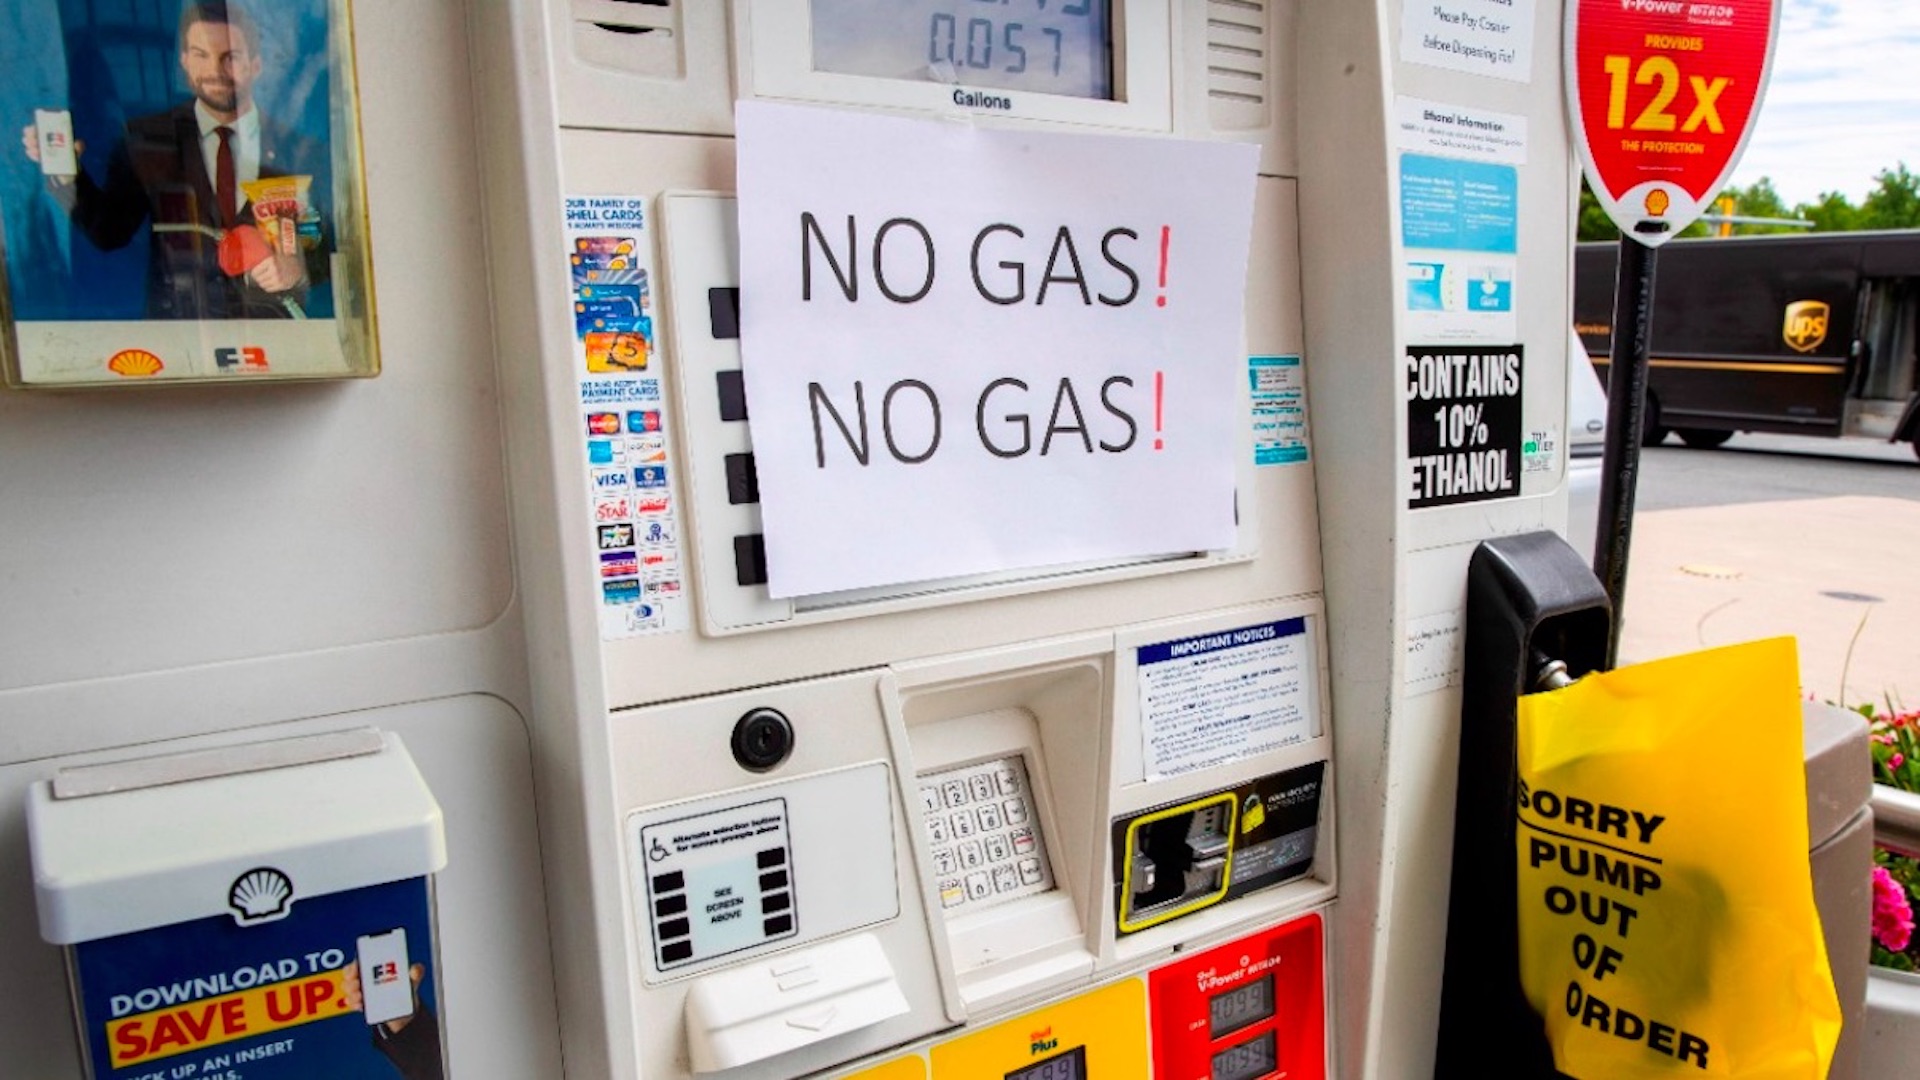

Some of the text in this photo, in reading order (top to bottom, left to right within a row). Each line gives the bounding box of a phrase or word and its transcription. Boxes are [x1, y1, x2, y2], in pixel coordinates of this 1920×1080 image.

[1434, 5, 1460, 23] Please
[1462, 12, 1477, 31] Pay
[929, 13, 1062, 77] 0.057
[1644, 34, 1703, 51] PROVIDES
[953, 89, 1012, 110] Gallons
[1423, 110, 1504, 132] Ethanol Information
[1621, 139, 1705, 154] THE PROTECTION
[566, 209, 643, 220] SHELL CARDS
[590, 200, 624, 208] FAMILY
[627, 200, 641, 208] OF
[800, 211, 1171, 308] NO GAS!
[1406, 354, 1520, 401] CONTAINS
[582, 386, 659, 397] PAYMENT CARDS
[808, 370, 1164, 468] NO GAS!
[1434, 402, 1490, 448] 10%
[596, 474, 627, 486] VISA
[1407, 449, 1513, 500] ETHANOL
[1171, 626, 1276, 656] IMPORTANT NOTICES
[1517, 777, 1665, 844] SORRY
[673, 816, 781, 843] Alternate selection buttons
[691, 839, 719, 849] screen
[756, 825, 779, 835] above
[1530, 836, 1662, 896] PUMP
[706, 897, 744, 914] SCREEN
[714, 886, 732, 898] SEE
[711, 910, 742, 924] ABOVE
[1544, 886, 1638, 938] OUT
[1572, 933, 1624, 981] OF
[110, 948, 345, 1017] DOWNLOAD TO
[1198, 968, 1246, 992] V-Power
[115, 979, 348, 1061] SAVE UP.
[1565, 980, 1711, 1070] ORDER
[171, 1063, 197, 1079] UP
[202, 1054, 230, 1072] AN
[235, 1038, 294, 1064] INSERT
[1031, 1038, 1058, 1055] Plus
